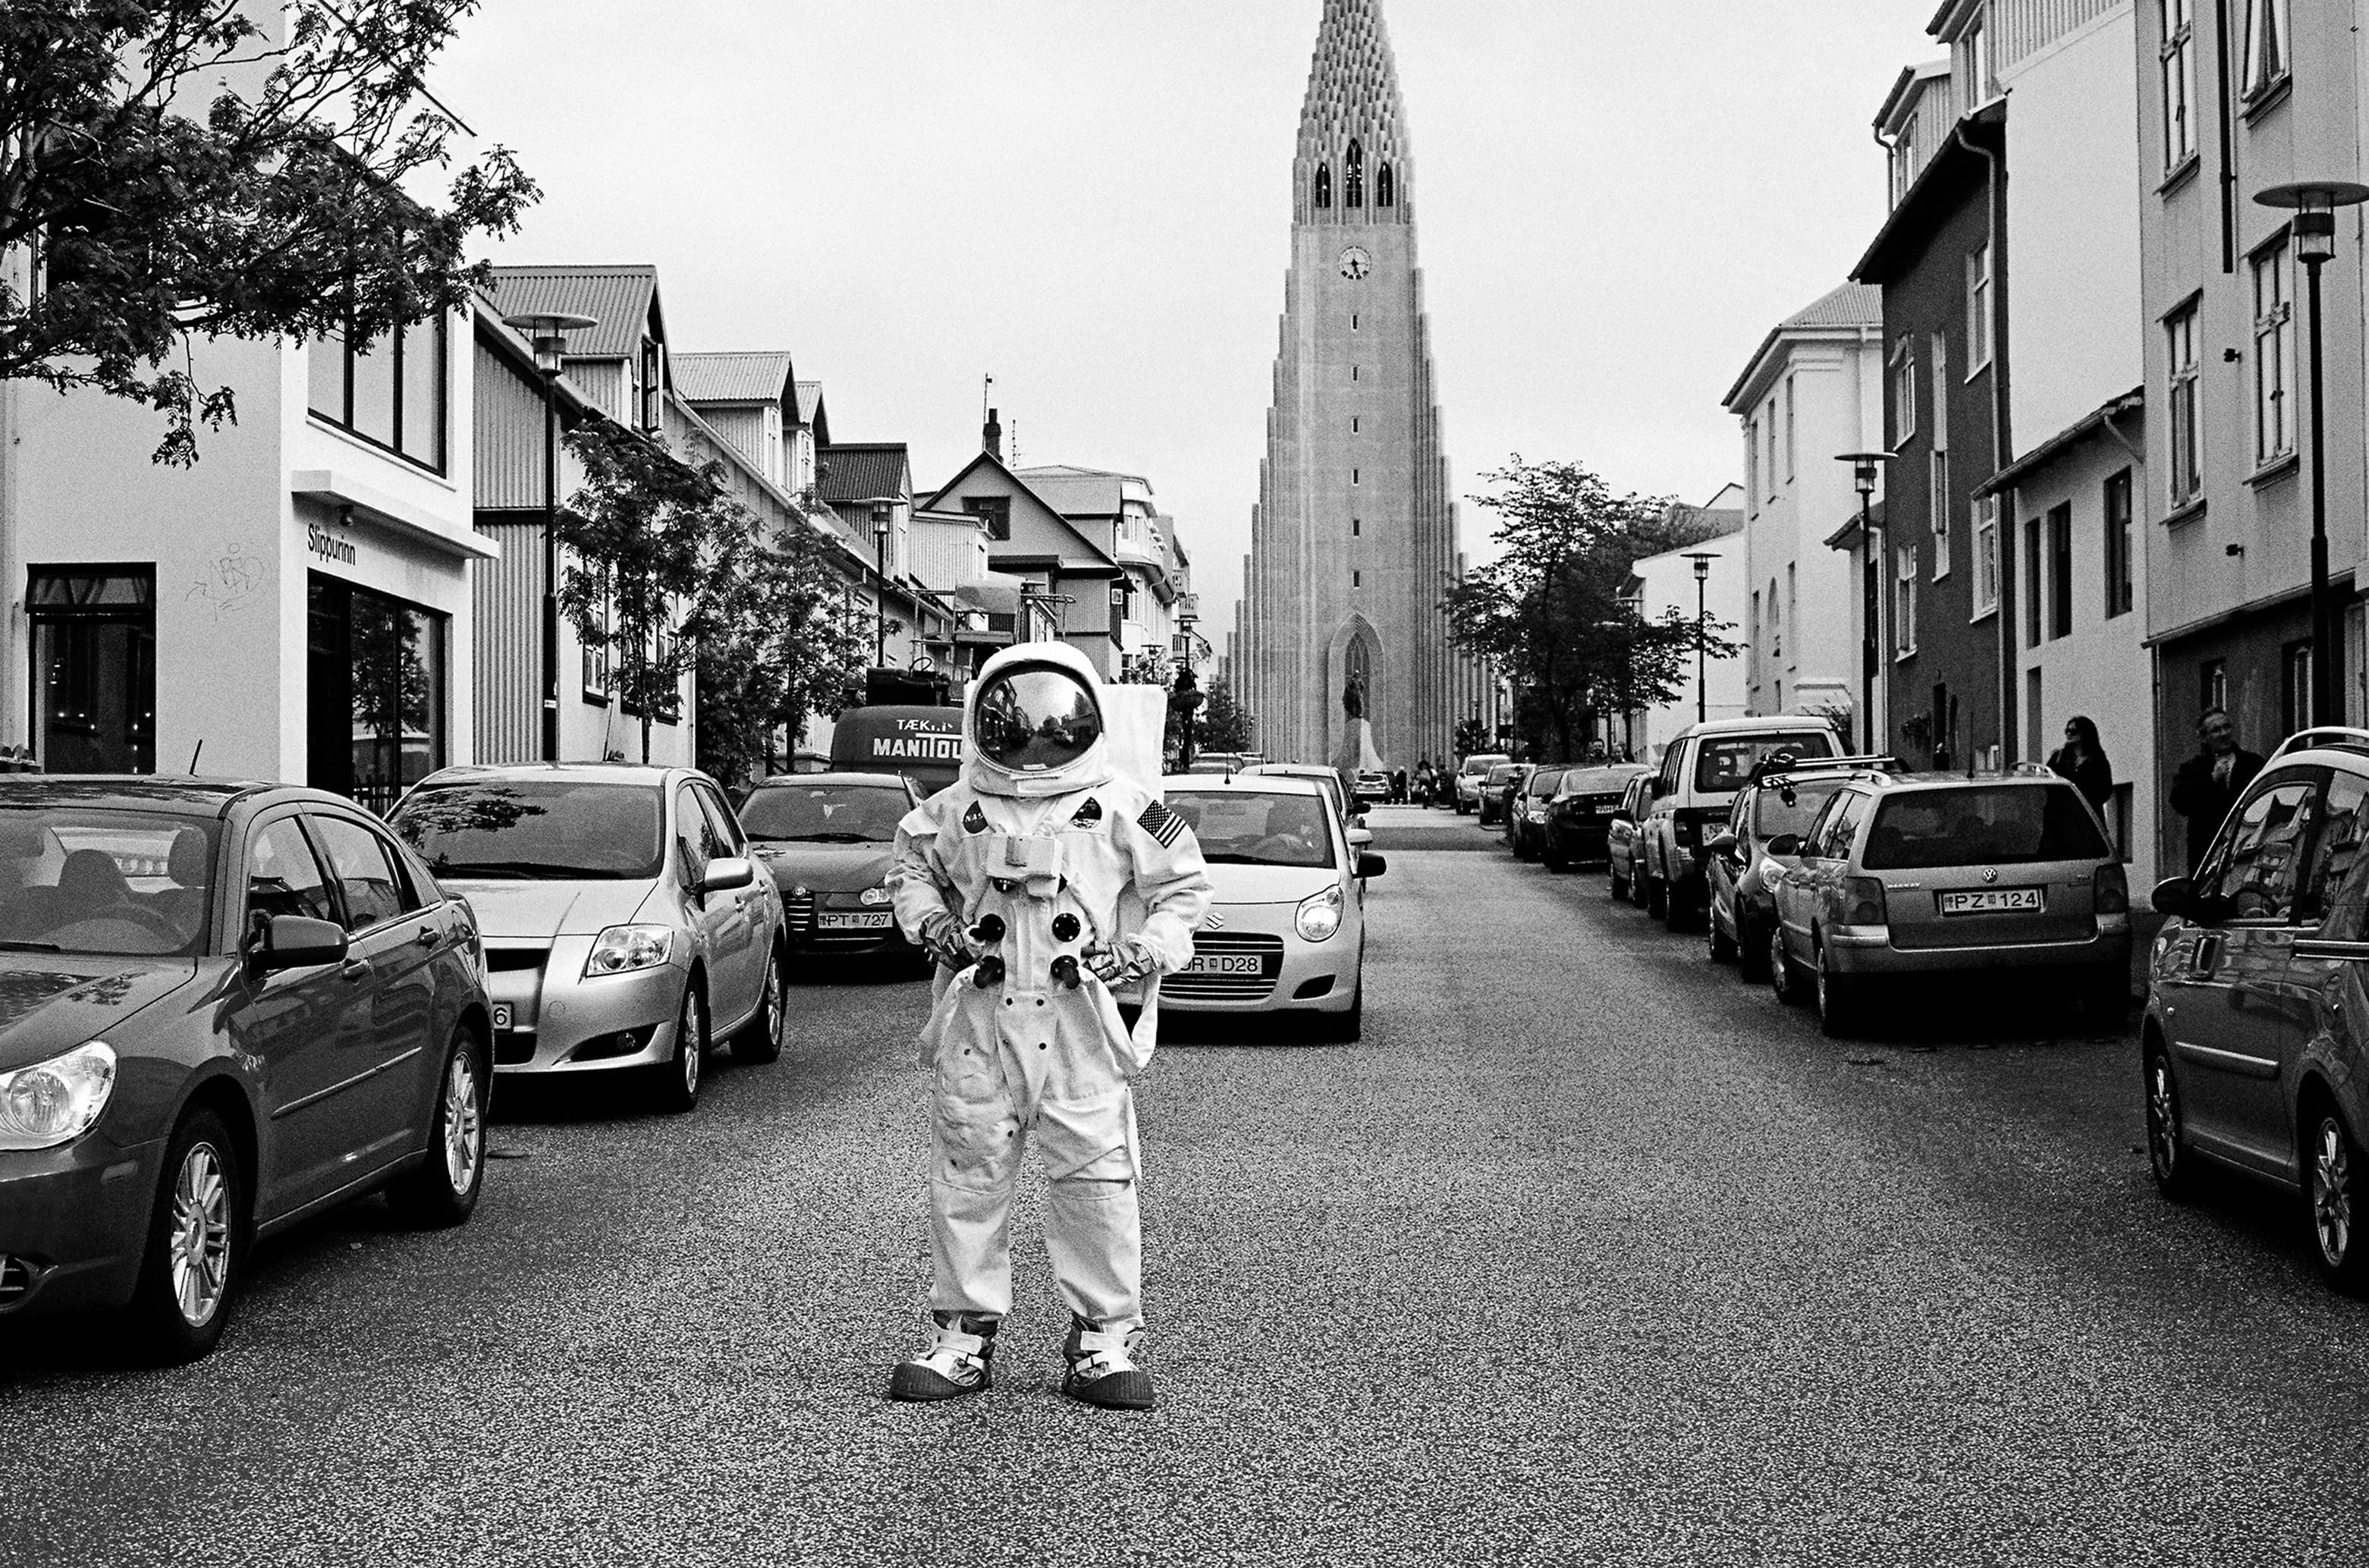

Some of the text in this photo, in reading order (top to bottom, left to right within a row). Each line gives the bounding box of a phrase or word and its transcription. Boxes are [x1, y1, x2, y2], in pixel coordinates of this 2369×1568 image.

[308, 523, 356, 566] Slippurinn
[1955, 891, 2037, 910] PZ 124
[828, 913, 889, 926] PT 727
[1221, 957, 1258, 972] D28
